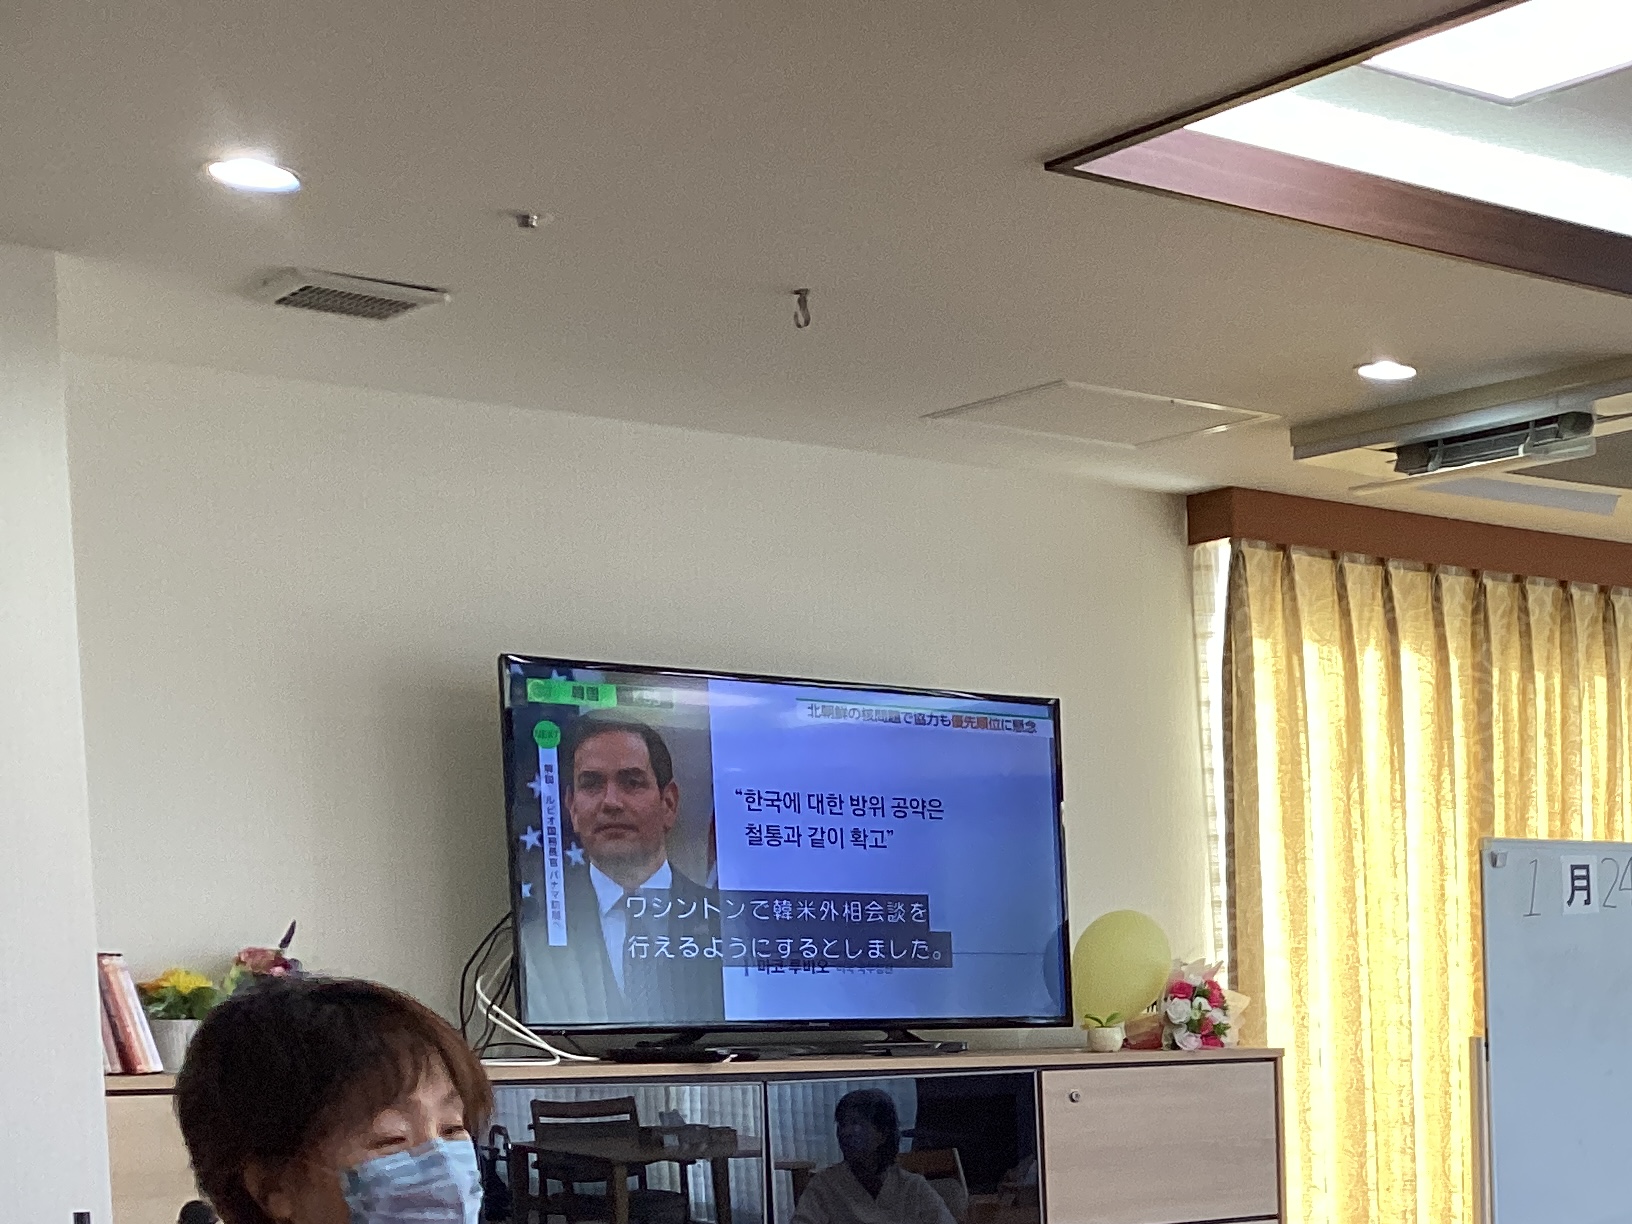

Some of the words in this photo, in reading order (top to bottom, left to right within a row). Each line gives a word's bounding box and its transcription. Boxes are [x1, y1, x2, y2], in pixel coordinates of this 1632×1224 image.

[807, 792, 845, 816] 대한
[849, 795, 886, 819] 방위
[890, 797, 945, 821] 공약은
[744, 823, 803, 848] 철통과
[807, 826, 845, 850] 같이
[625, 895, 928, 924] ワシントンで韓米外相会談を
[627, 935, 943, 961] 行えるようにするとしました。
